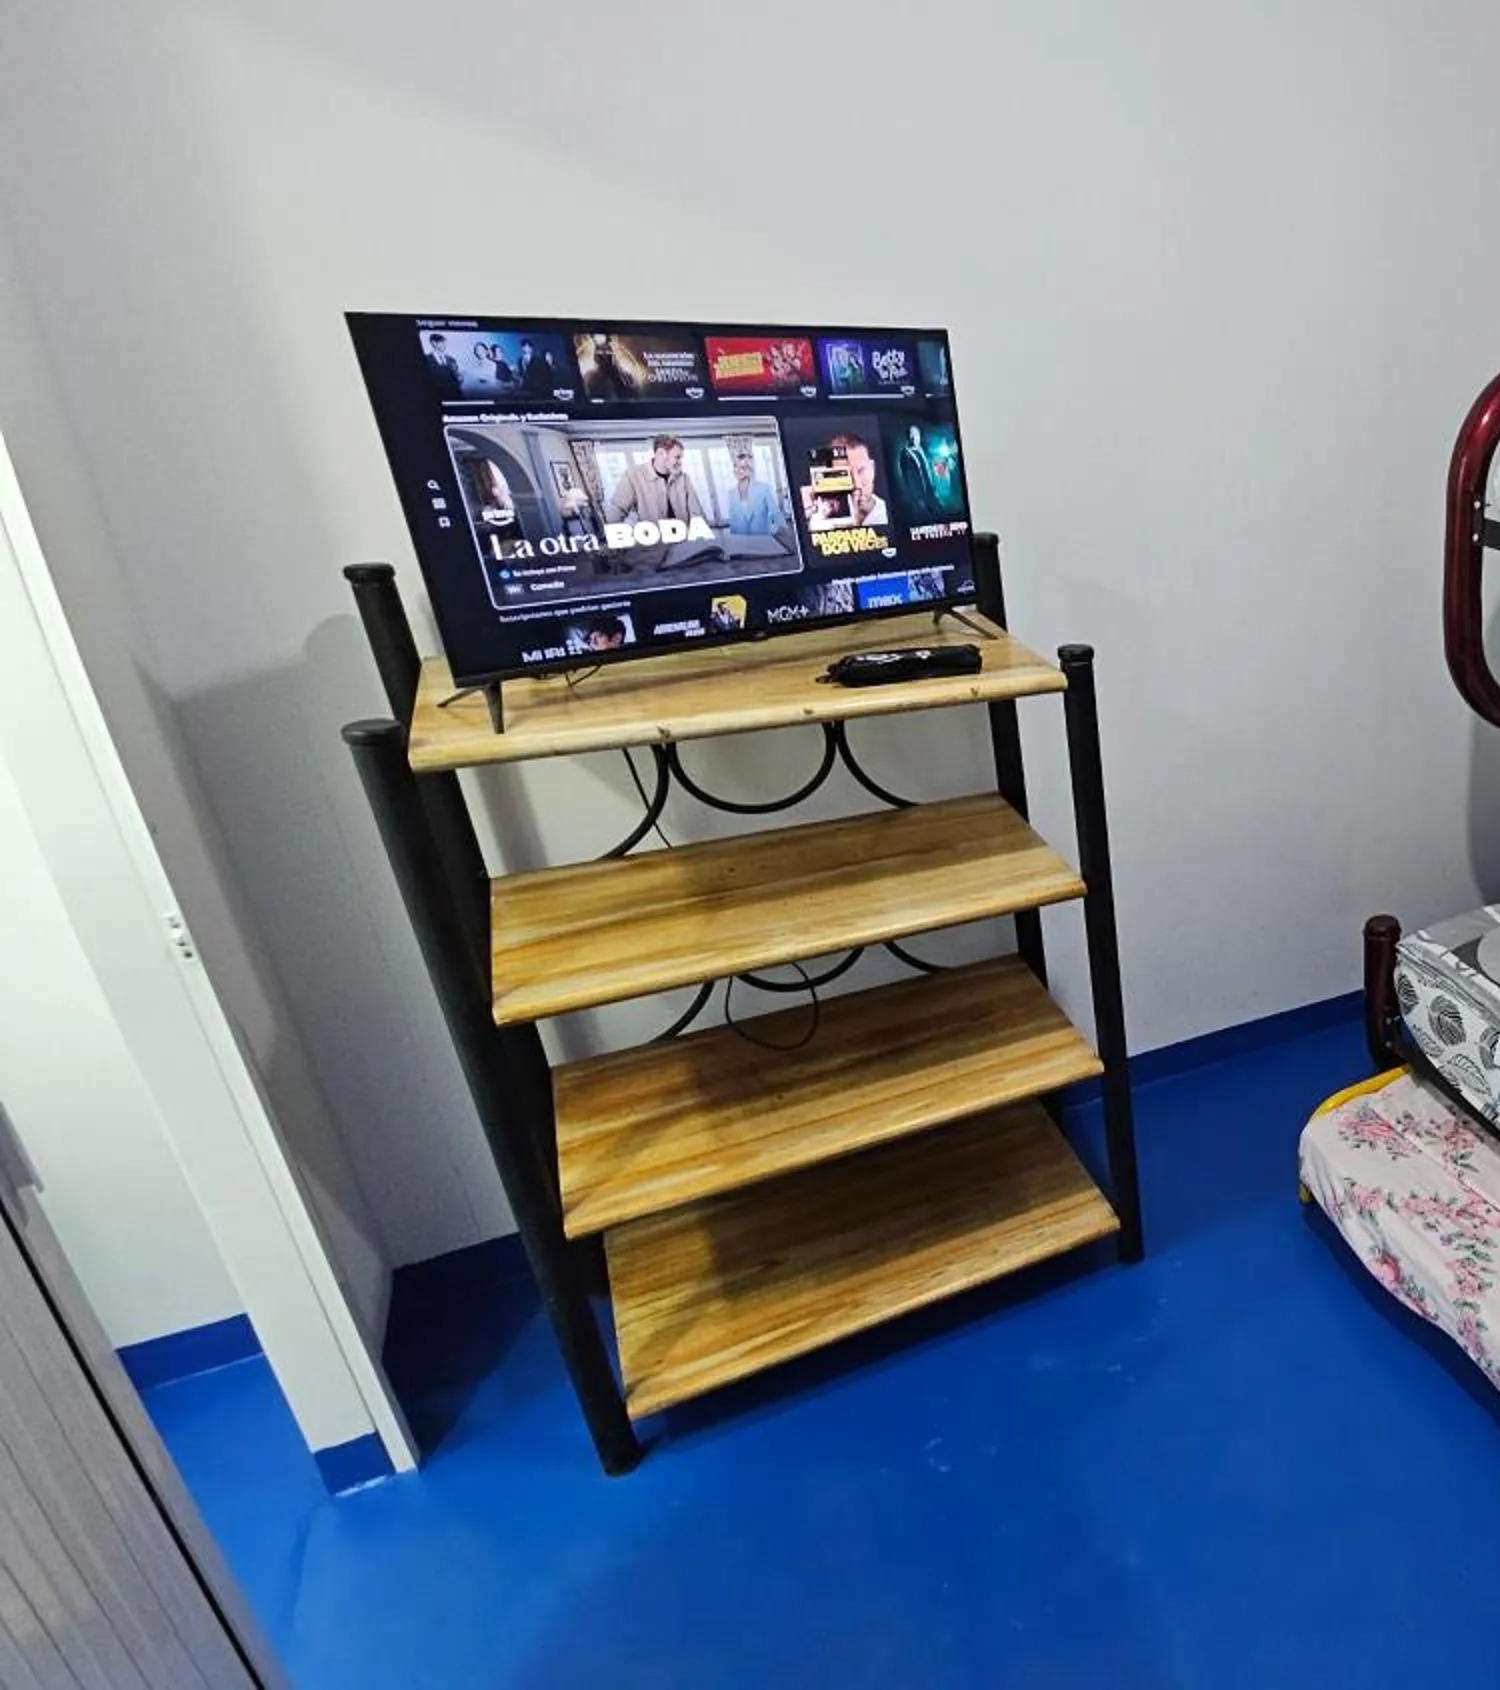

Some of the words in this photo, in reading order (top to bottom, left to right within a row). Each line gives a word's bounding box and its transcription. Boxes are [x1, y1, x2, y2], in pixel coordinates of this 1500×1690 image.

[490, 534, 535, 560] La
[539, 532, 600, 555] otra
[603, 516, 715, 549] BODA
[766, 605, 809, 623] MGM+
